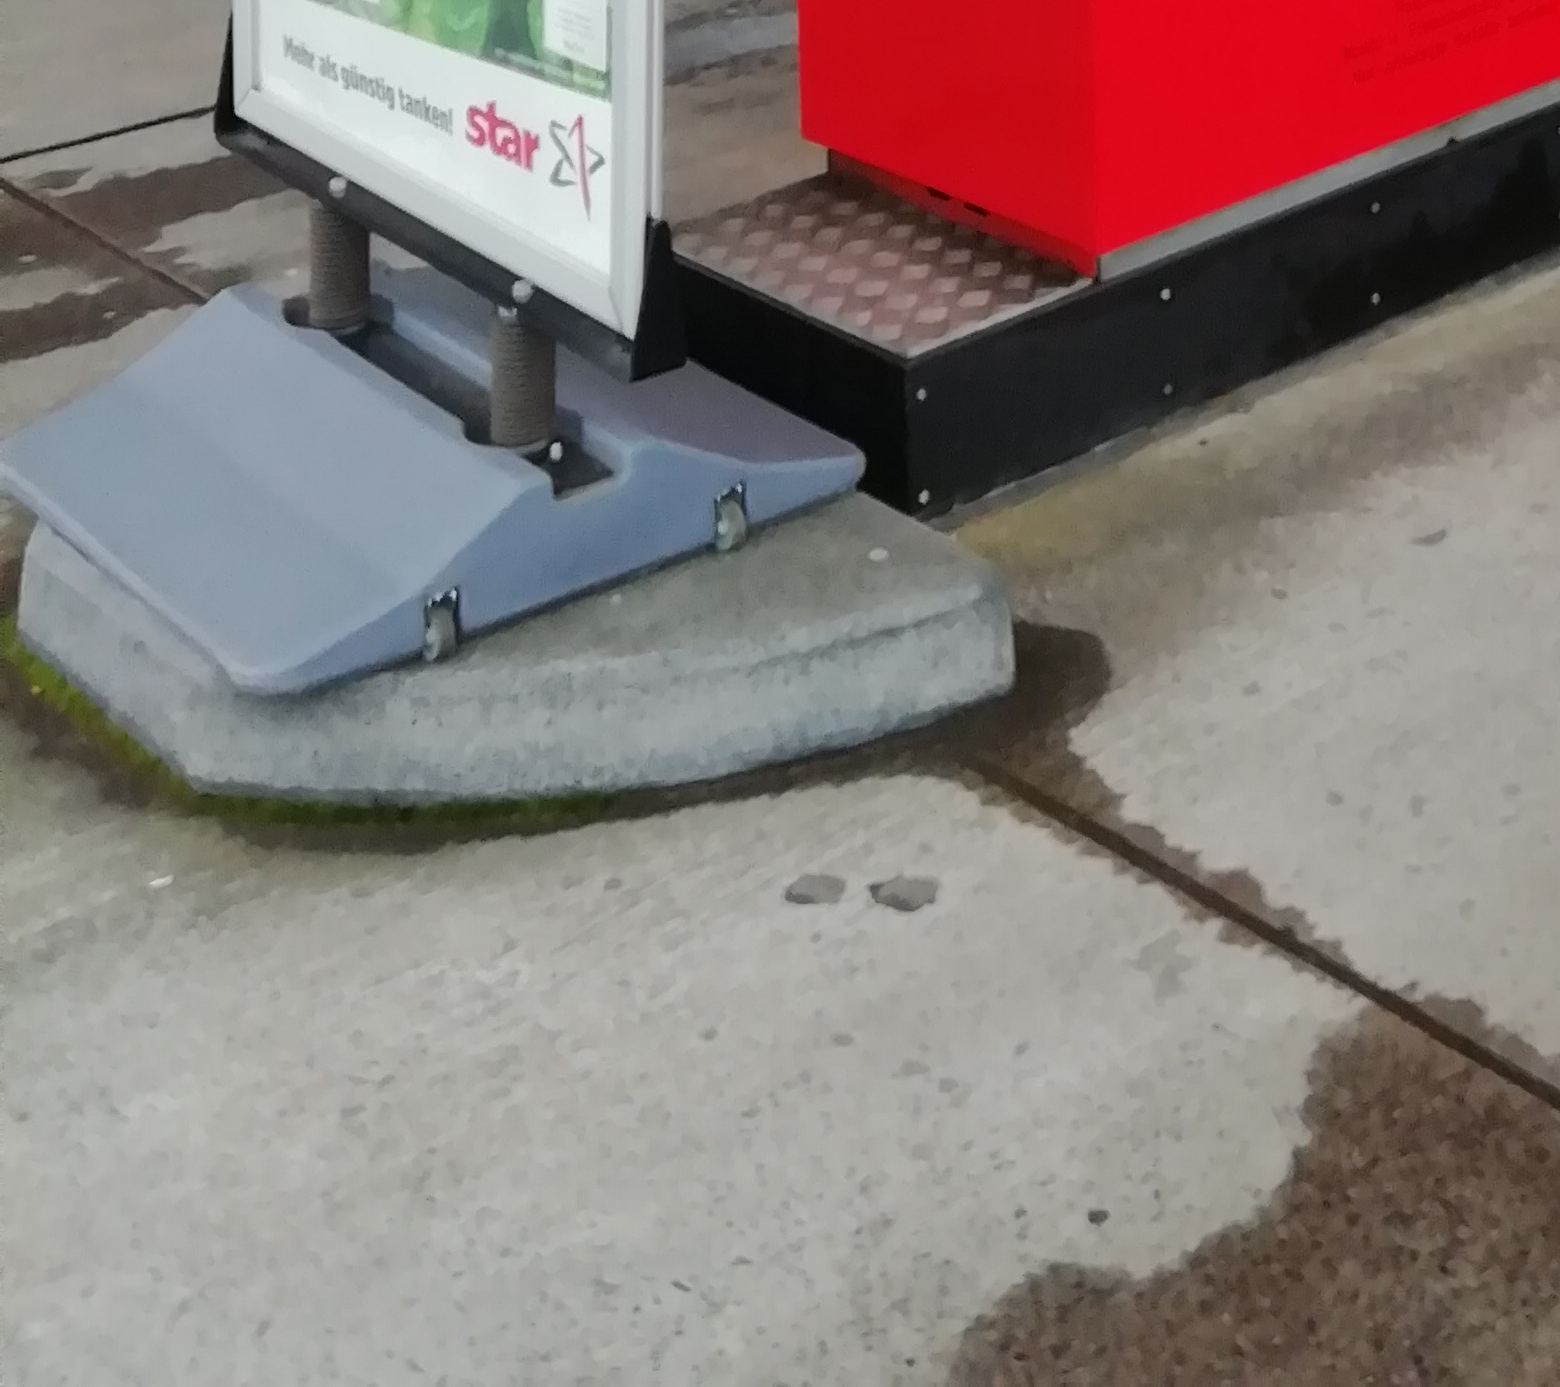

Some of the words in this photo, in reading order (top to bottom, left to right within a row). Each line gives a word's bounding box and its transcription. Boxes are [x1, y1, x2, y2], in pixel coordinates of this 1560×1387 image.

[318, 54, 339, 83] als
[340, 63, 396, 111] günstig
[465, 99, 540, 172] star
